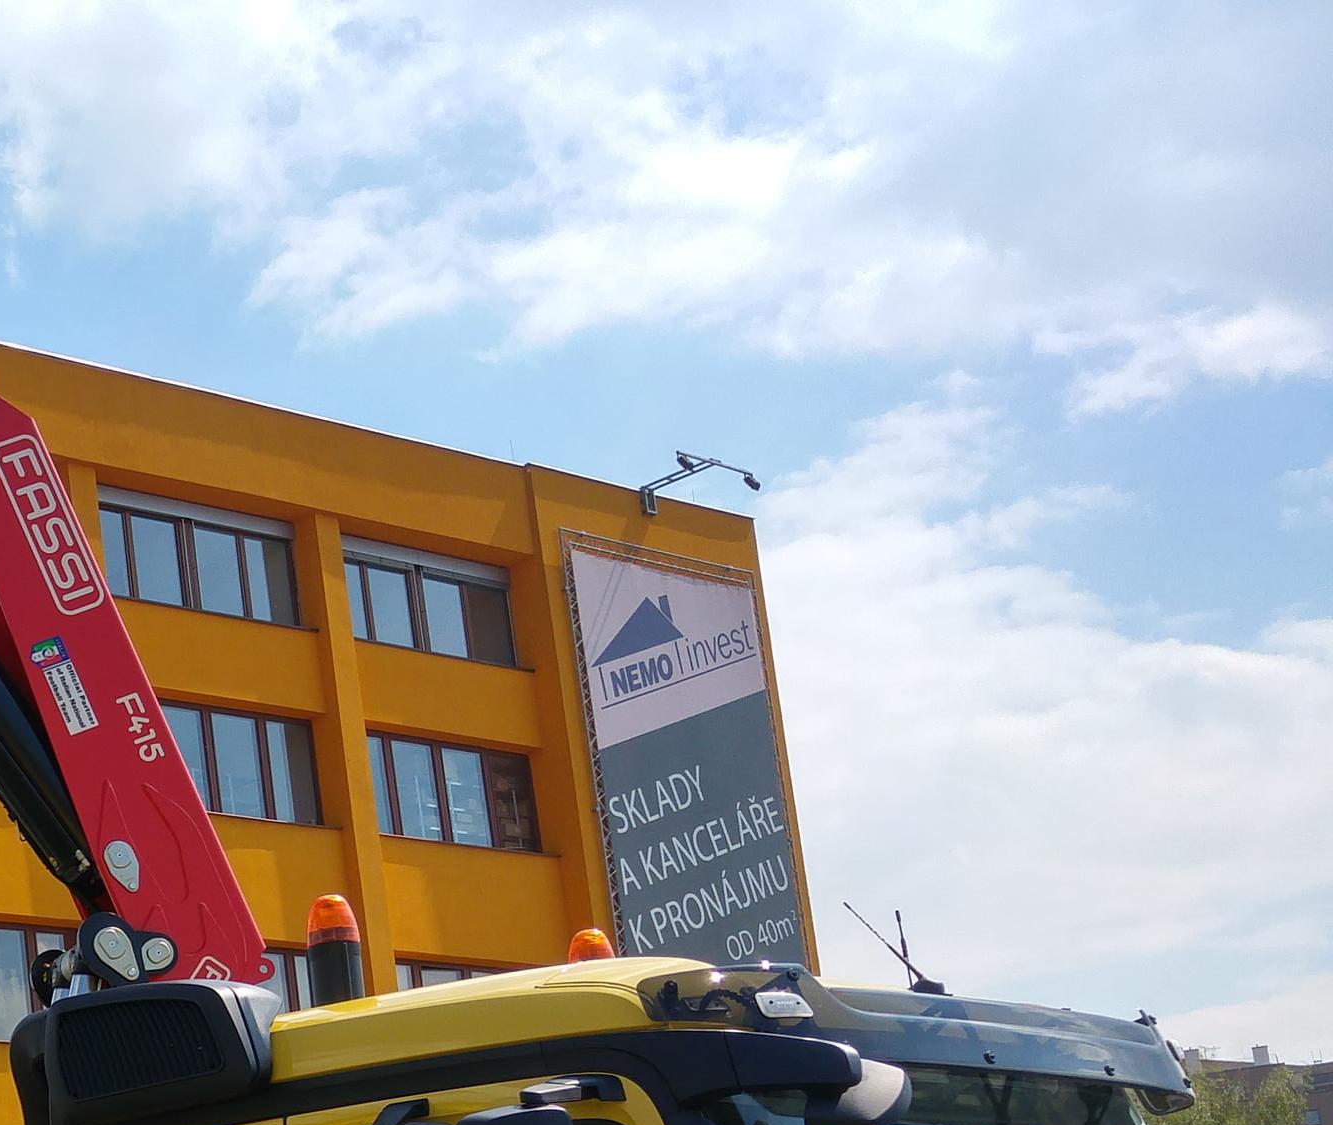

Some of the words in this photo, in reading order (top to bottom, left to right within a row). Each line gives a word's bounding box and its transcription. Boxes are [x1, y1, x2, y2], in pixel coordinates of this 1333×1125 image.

[1, 447, 96, 602] FASSI
[65, 663, 83, 694] Official
[79, 694, 95, 725] Partner
[609, 652, 674, 699] NEMO
[685, 619, 755, 673] invest
[46, 671, 64, 702] Football
[59, 702, 72, 724] Team
[69, 697, 87, 729] National
[115, 691, 166, 763] F415
[609, 764, 705, 835] SKLADY
[619, 857, 642, 896] A
[641, 795, 784, 887] KANCELÁŘE
[629, 918, 654, 954] K
[653, 855, 790, 947] PRONÁJMU
[726, 930, 756, 961] OD
